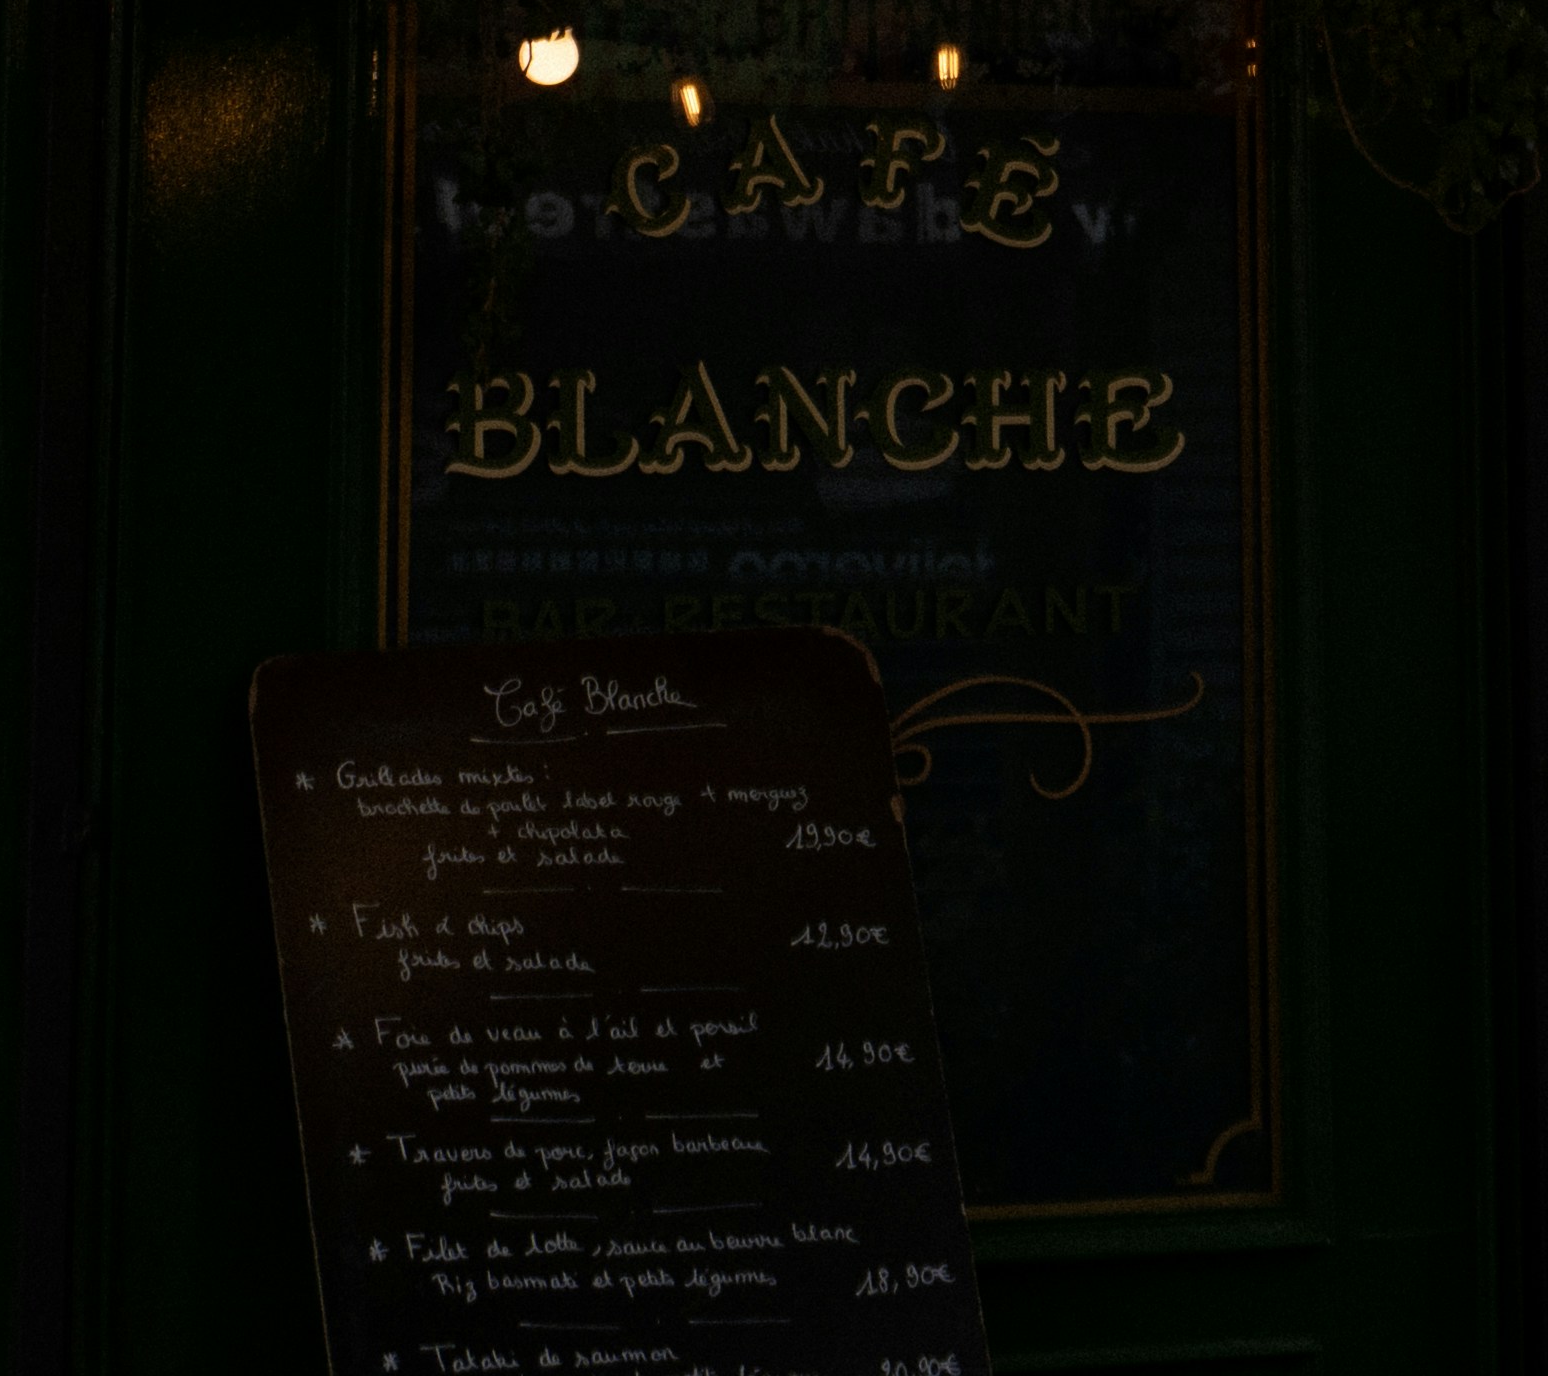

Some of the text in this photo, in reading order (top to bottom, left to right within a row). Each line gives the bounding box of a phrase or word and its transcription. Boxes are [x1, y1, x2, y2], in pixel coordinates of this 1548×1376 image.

[605, 112, 1062, 250] CAFÉ
[444, 359, 1185, 481] BLANCHE
[663, 582, 1142, 640] RESTAURANT
[484, 675, 698, 732] Café Blanche
[784, 822, 878, 853] 19,90€
[351, 903, 420, 940] Fish
[466, 916, 526, 939] chips
[790, 922, 891, 949] 12,90€
[373, 1015, 432, 1050] Foie
[814, 1040, 916, 1073] 14,90€
[835, 1138, 934, 1172] 14,90€
